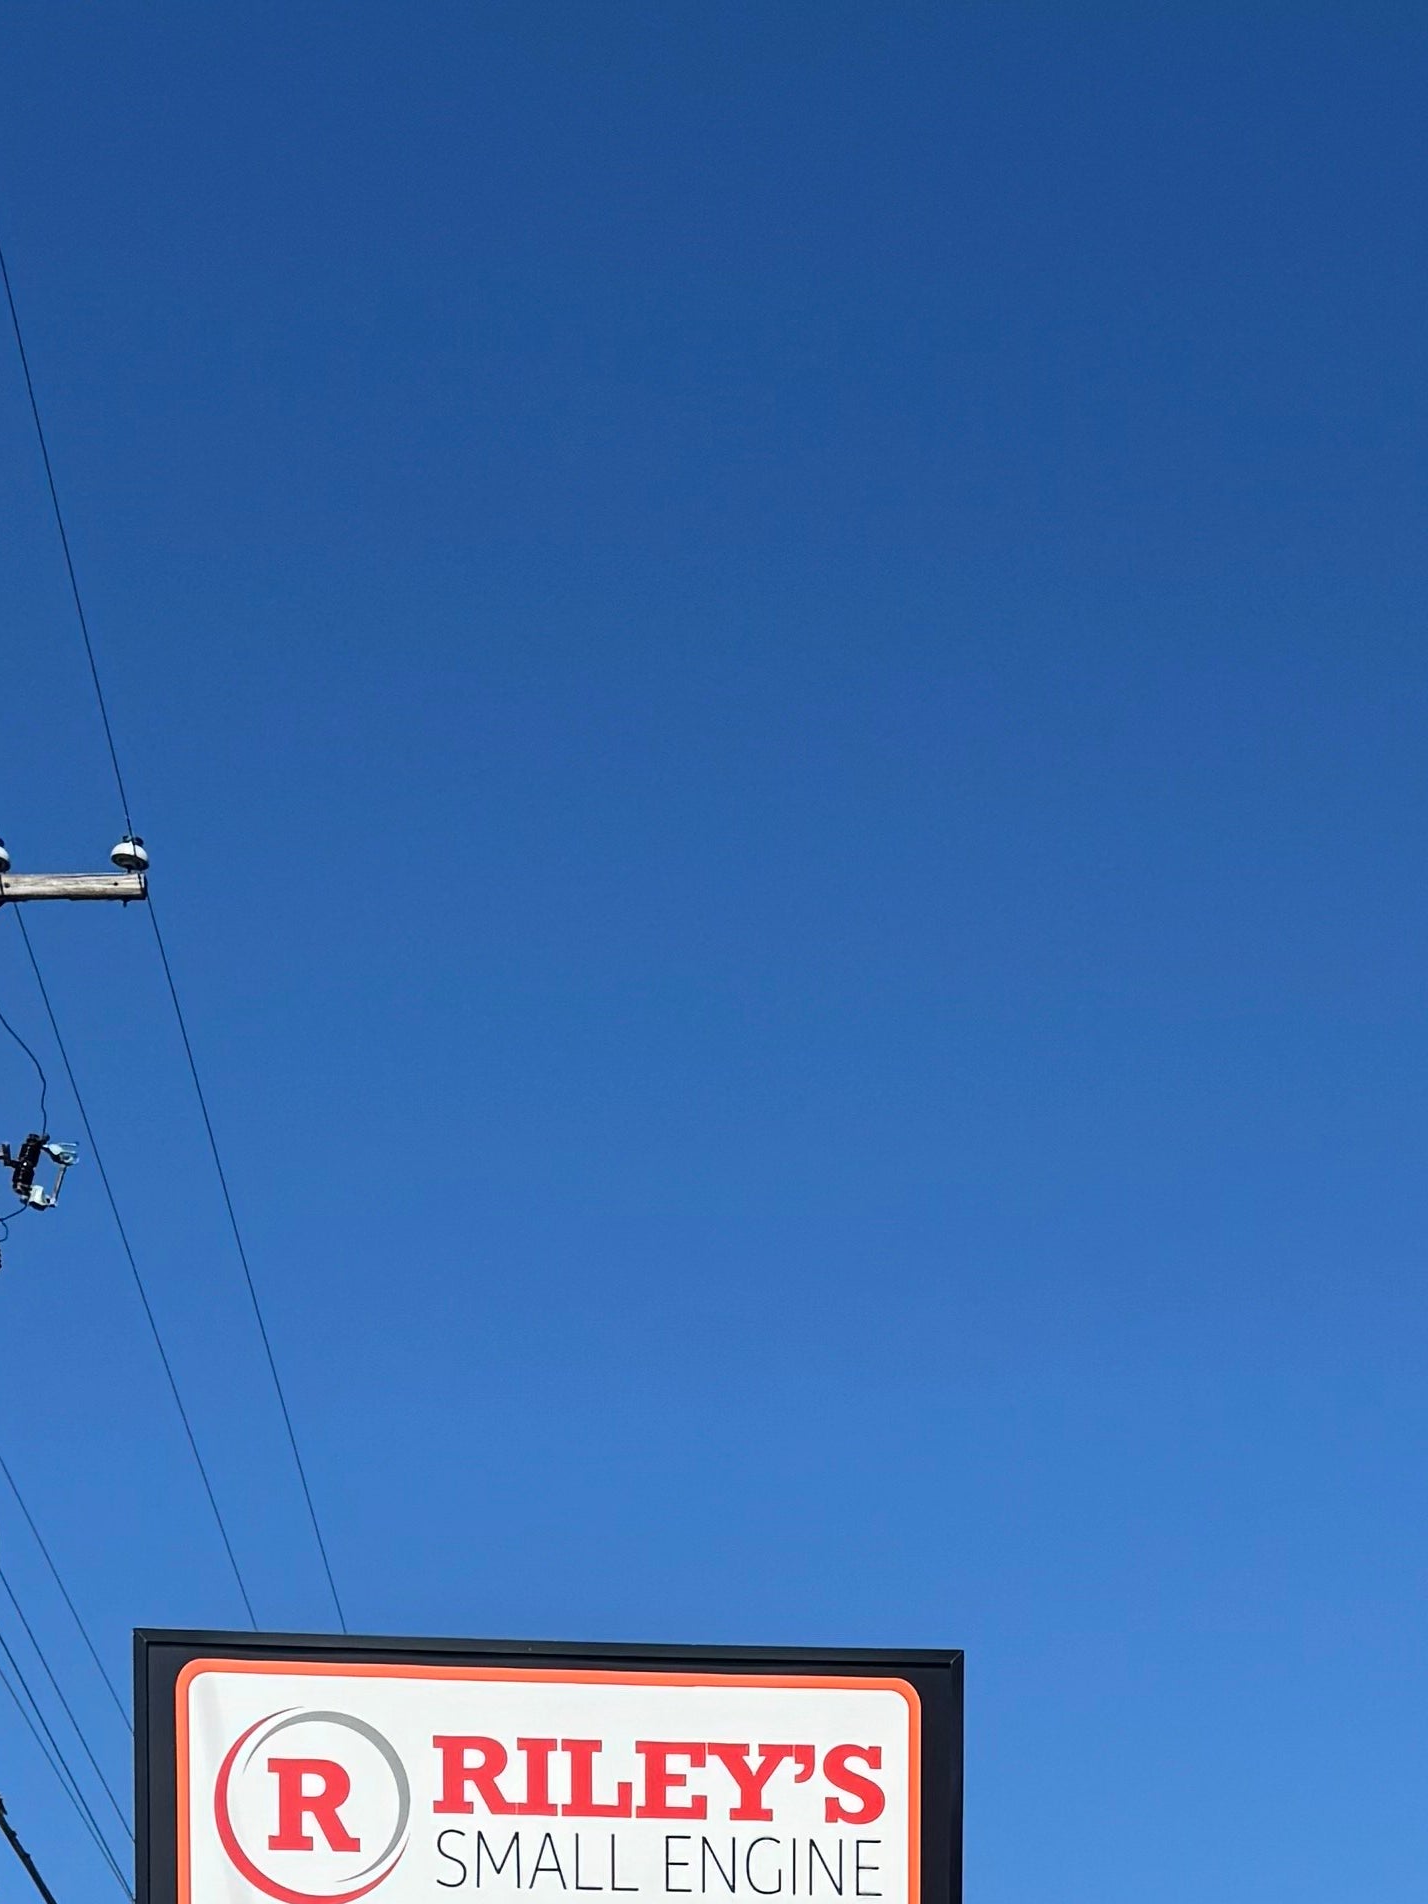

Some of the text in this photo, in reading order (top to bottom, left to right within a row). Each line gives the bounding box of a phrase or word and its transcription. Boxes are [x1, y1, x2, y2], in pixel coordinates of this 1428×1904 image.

[268, 1758, 361, 1853] R
[432, 1735, 887, 1825] RILEY'S
[436, 1828, 883, 1897] SMALL ENGINE
